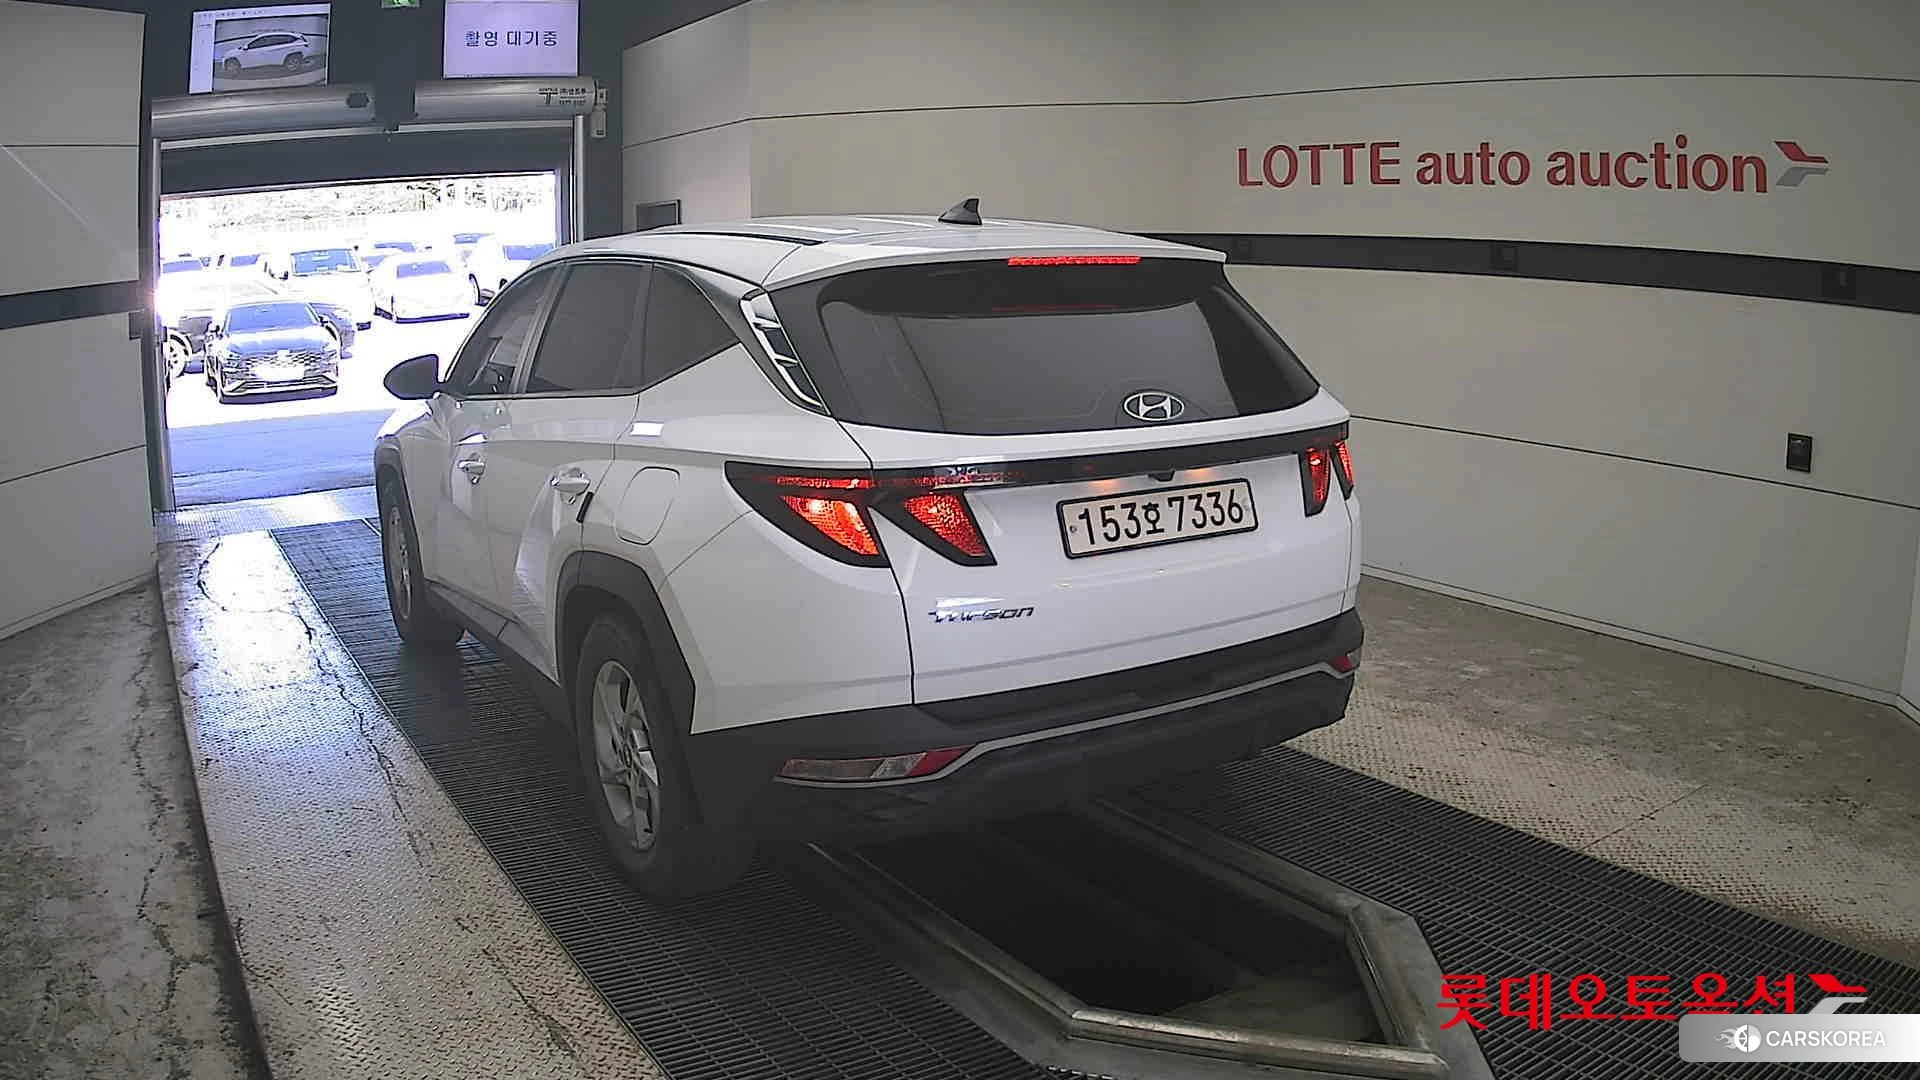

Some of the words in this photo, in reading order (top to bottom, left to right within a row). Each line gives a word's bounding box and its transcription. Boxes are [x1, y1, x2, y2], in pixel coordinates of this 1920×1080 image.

[464, 30, 498, 47] 촬영
[1237, 141, 1401, 188] LOTTE
[1416, 141, 1531, 186] auto
[1546, 134, 1768, 193] auction
